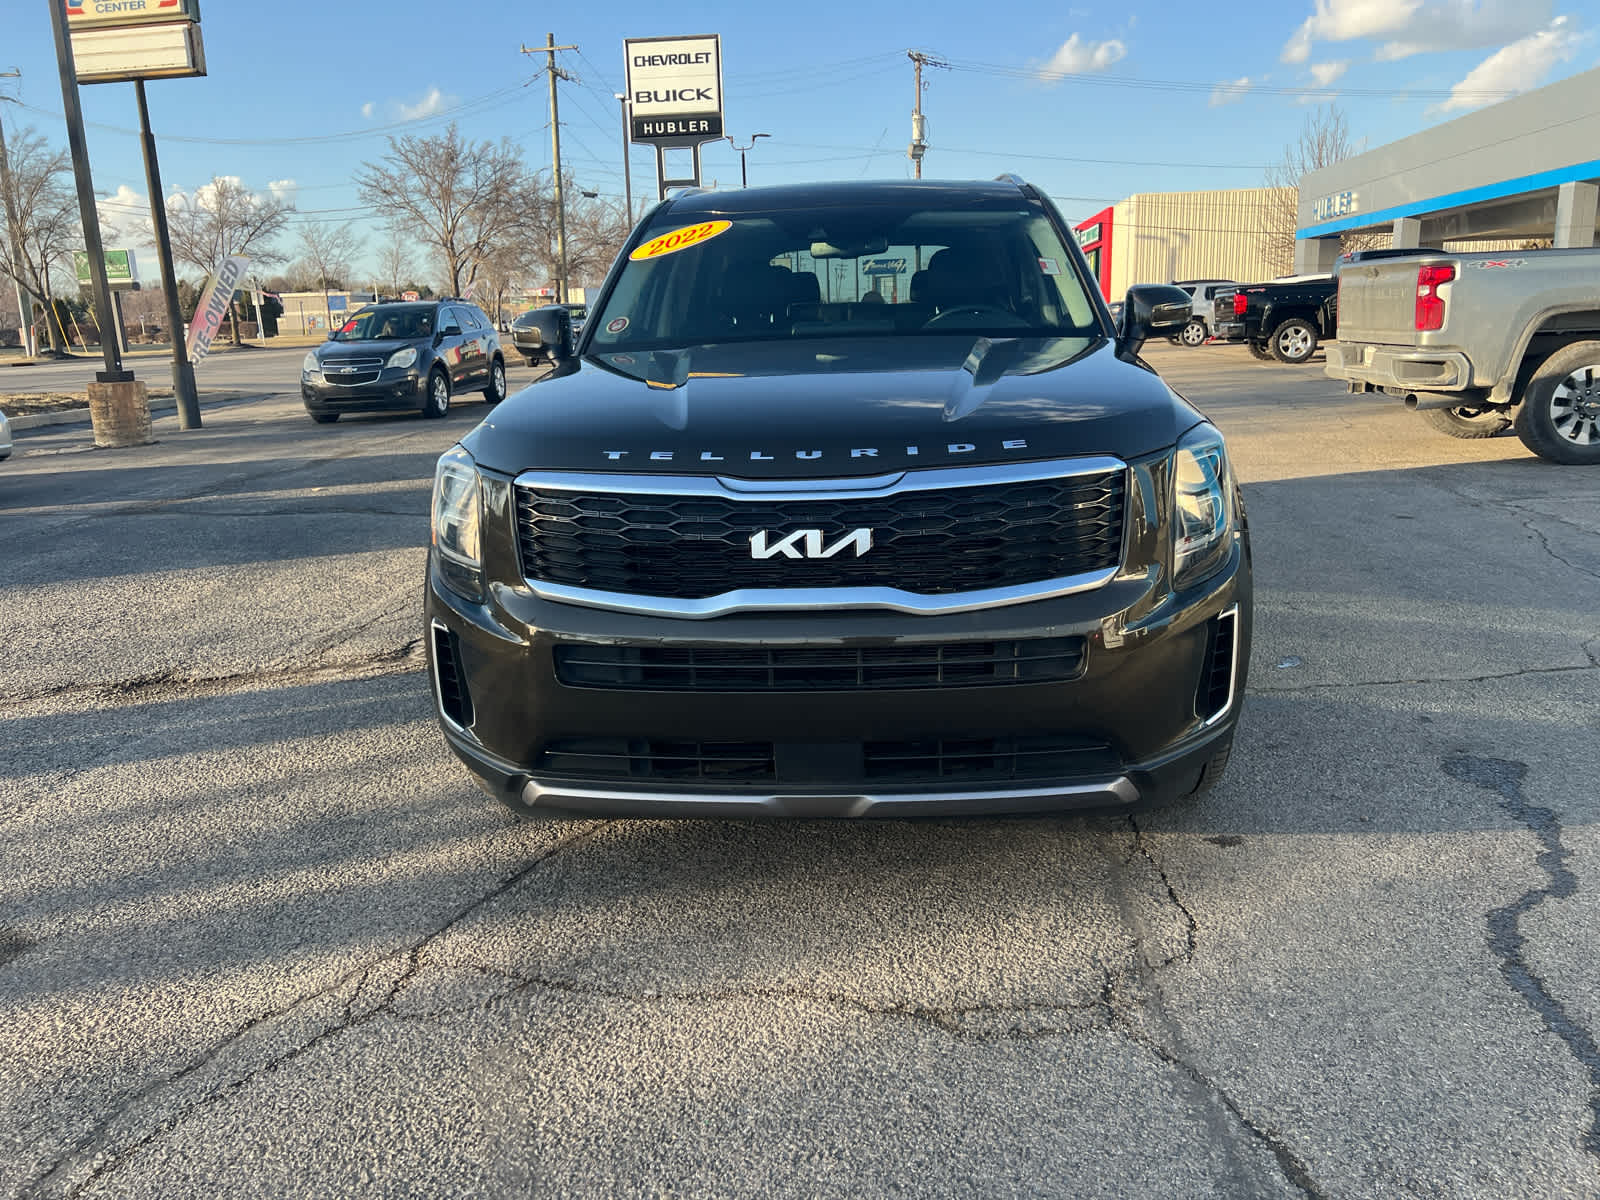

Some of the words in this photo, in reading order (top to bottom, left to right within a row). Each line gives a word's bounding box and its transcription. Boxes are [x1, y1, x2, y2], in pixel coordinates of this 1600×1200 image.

[96, 1, 146, 13] CENTER
[633, 52, 712, 67] CHEVROLET
[635, 87, 713, 104] BUICK
[643, 120, 709, 134] HUBLER
[648, 223, 713, 256] 2022
[603, 439, 1027, 460] TELLURIDE
[749, 527, 873, 559] KIA
